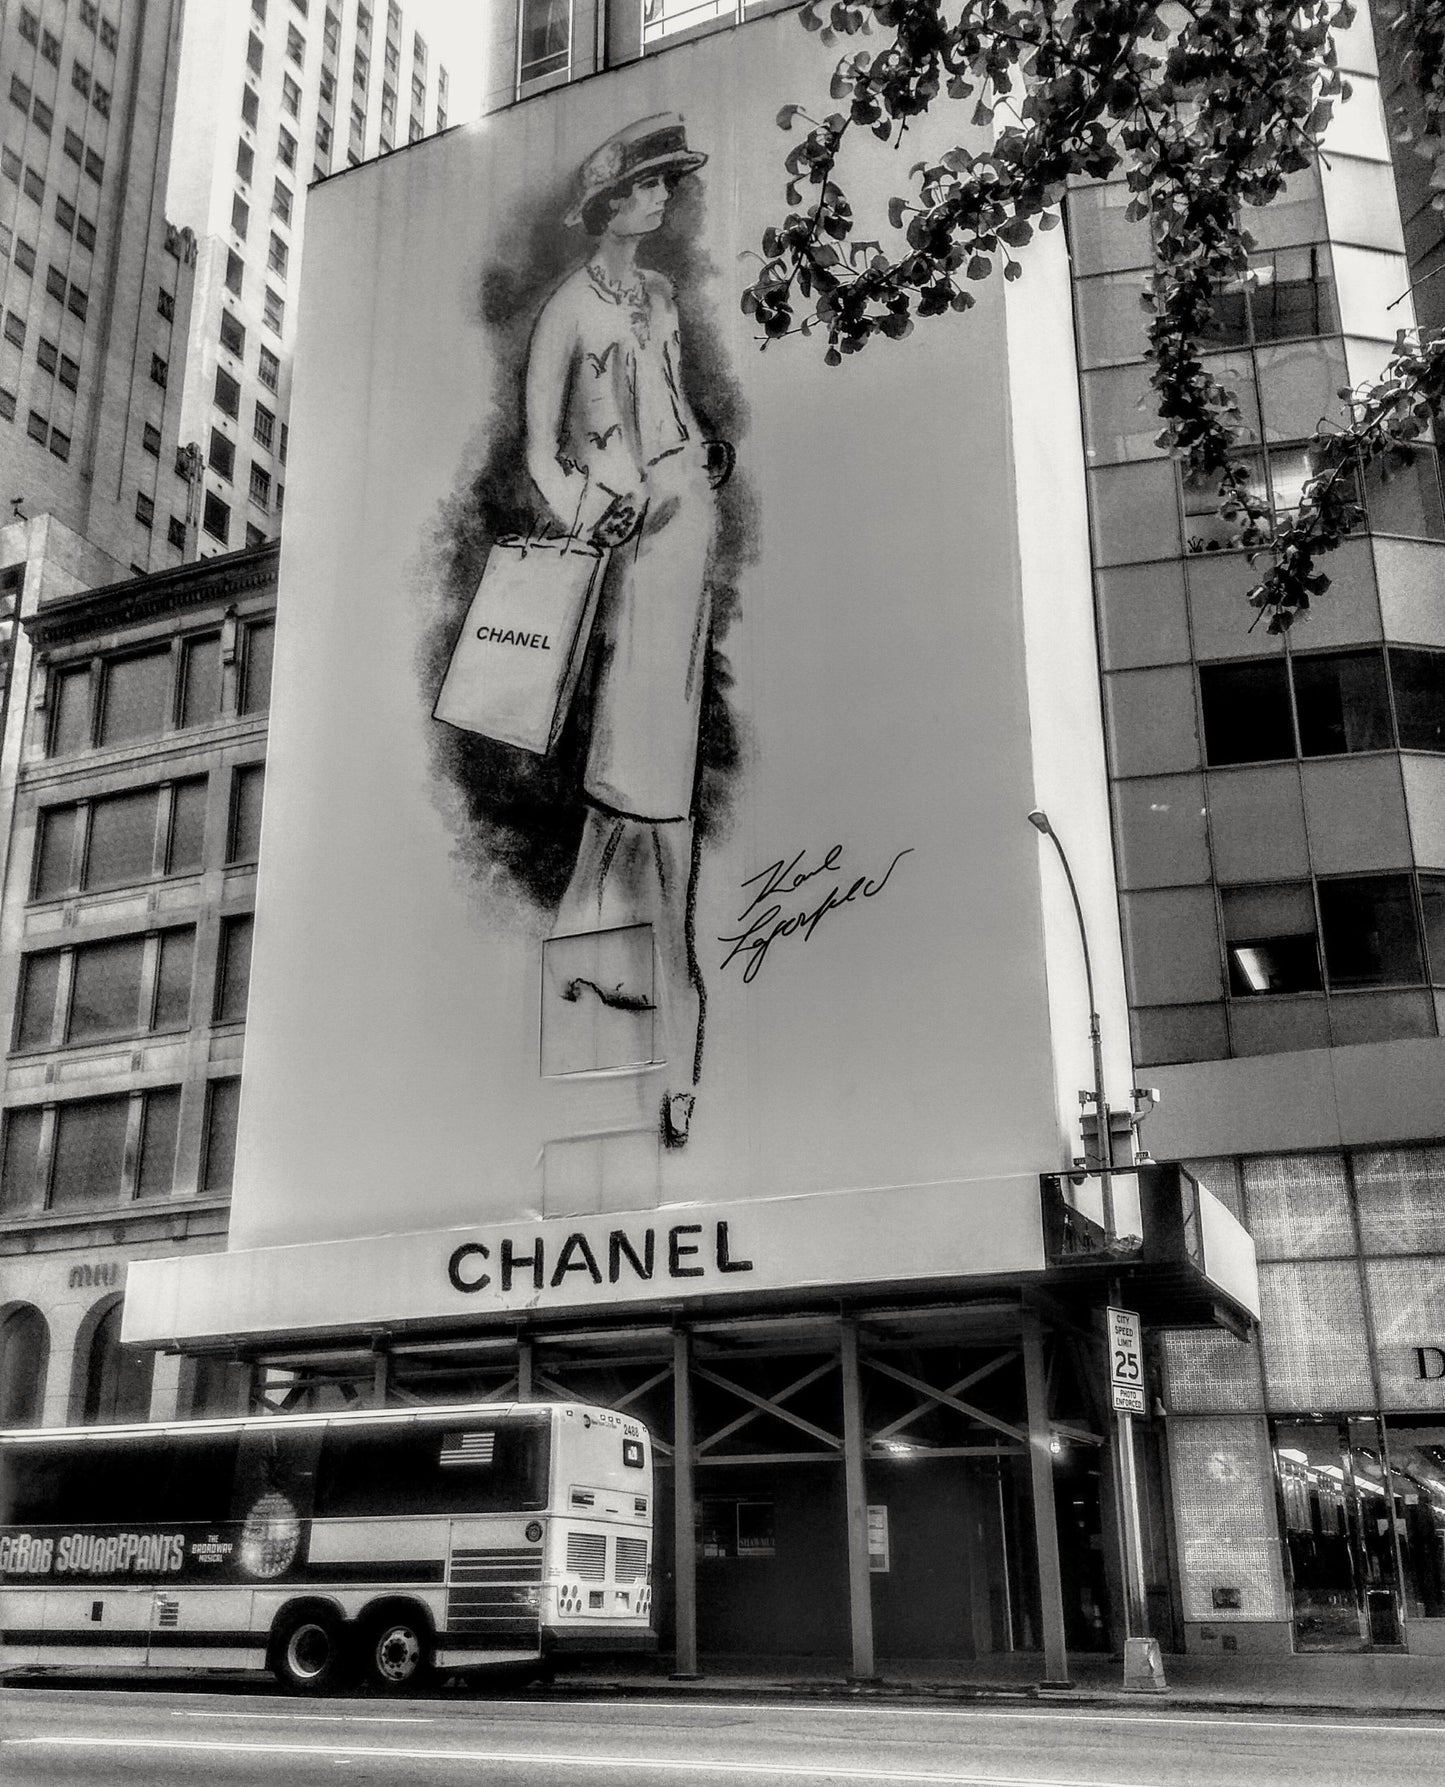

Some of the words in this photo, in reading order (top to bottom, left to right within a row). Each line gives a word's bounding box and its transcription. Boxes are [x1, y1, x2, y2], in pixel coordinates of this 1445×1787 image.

[476, 626, 551, 650] CHANEL
[448, 1220, 754, 1294] CHANEL
[1116, 1314, 1129, 1324] CITY
[1115, 1325, 1133, 1337] SPEED
[1117, 1338, 1132, 1347] LIMIT
[1114, 1350, 1139, 1380] 25
[1120, 1389, 1136, 1399] PHOTO
[1115, 1397, 1142, 1408] ENFORCED
[207, 1534, 220, 1543] THE
[55, 1533, 185, 1574] SQUAREPANTS
[191, 1543, 233, 1554] BROADWAY
[198, 1553, 224, 1563] MUSICAL
